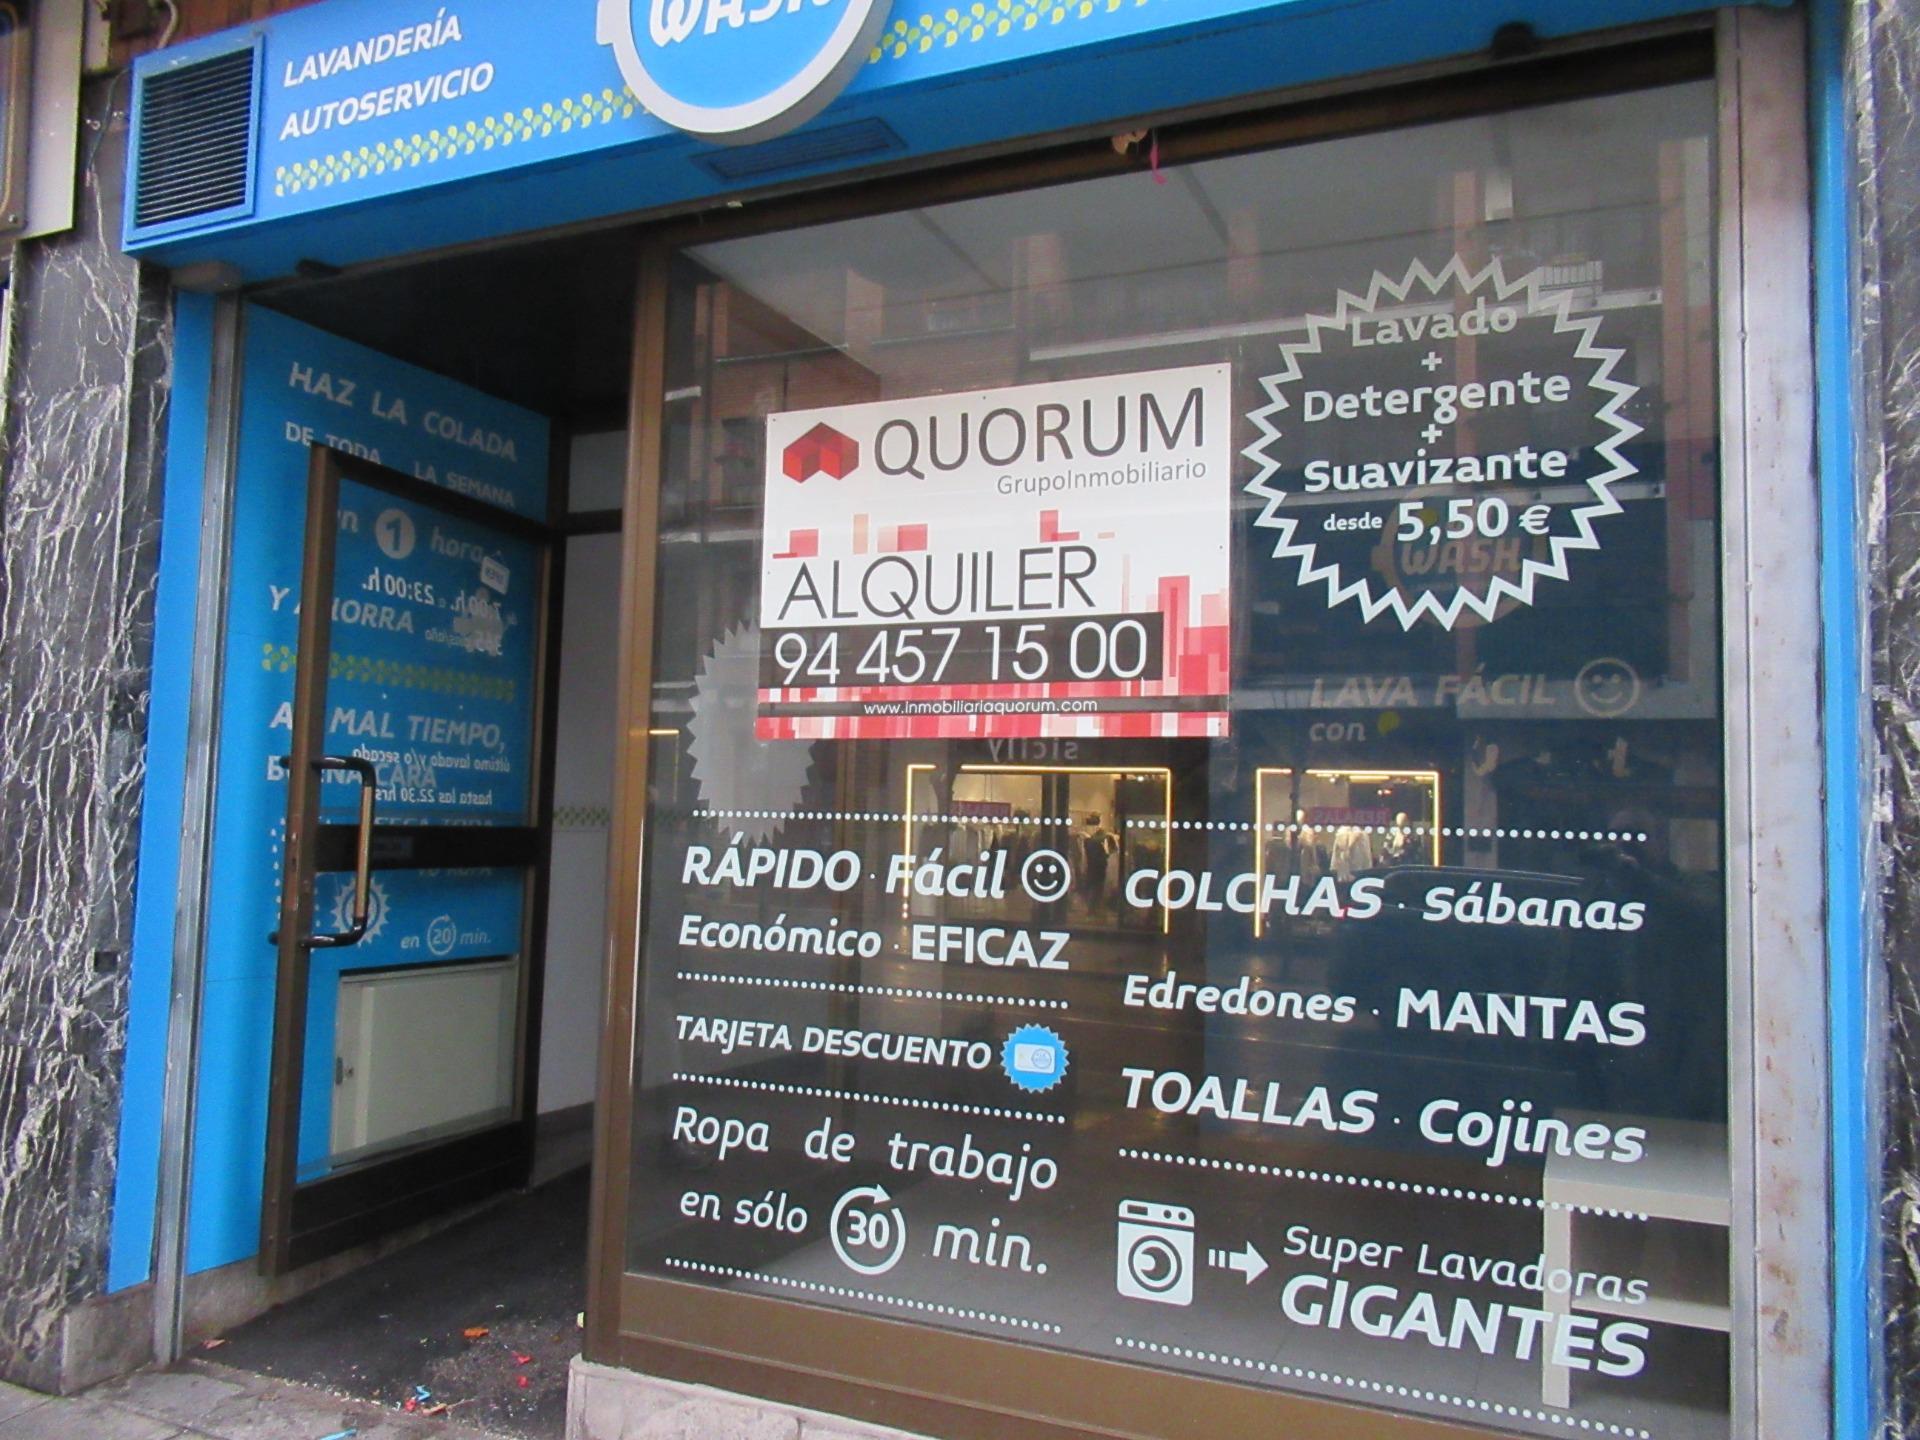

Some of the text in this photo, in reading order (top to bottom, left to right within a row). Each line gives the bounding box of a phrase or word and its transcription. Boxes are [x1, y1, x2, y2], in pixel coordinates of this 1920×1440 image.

[284, 8, 461, 87] LAVANDERÍA
[280, 62, 494, 140] AUTOSERVICIO
[1352, 297, 1518, 347] Lavado
[290, 362, 517, 462] HAZ LA COLADA
[1304, 371, 1570, 424] Detergente
[874, 387, 1204, 480] QUORUM
[285, 421, 314, 448] DE
[414, 461, 437, 483] LA
[447, 472, 515, 507] SEMANA
[997, 459, 1207, 496] GrupoInmobiliario
[1304, 446, 1567, 492] Suavizante
[338, 510, 358, 533] n
[1323, 498, 1551, 545] desde 5,50 €
[777, 545, 1097, 621] ALQUILER
[1401, 538, 1523, 575] WASH
[269, 584, 415, 635] Y ORRA
[774, 619, 1147, 685] 94 457 15 00
[864, 698, 1098, 716] www.inmobiliariaquorum.com
[1310, 663, 1556, 707] LAVA FÁCIL
[330, 707, 395, 738] MAL
[408, 714, 505, 755] TIEMPO,
[1309, 719, 1365, 742] con
[267, 755, 363, 786] BNA
[681, 831, 1006, 899] RÁPIDO Fácil
[1124, 868, 1645, 932] COLCHAS Sábanas
[400, 935, 420, 949] en
[679, 914, 1070, 970] Económico EFICAZ
[1122, 972, 1646, 1046] Edredones MANTAS
[676, 1015, 792, 1055] TARJETA
[802, 1026, 991, 1069] DESCUENTO
[1121, 1067, 1646, 1167] TOALLAS Cojines
[673, 1106, 1058, 1201] Ropa de trabajo
[680, 1190, 1048, 1275] en sólo 30 min.
[1283, 1225, 1649, 1306] Super Lavadoras
[1281, 1274, 1650, 1377] GIGANTES
